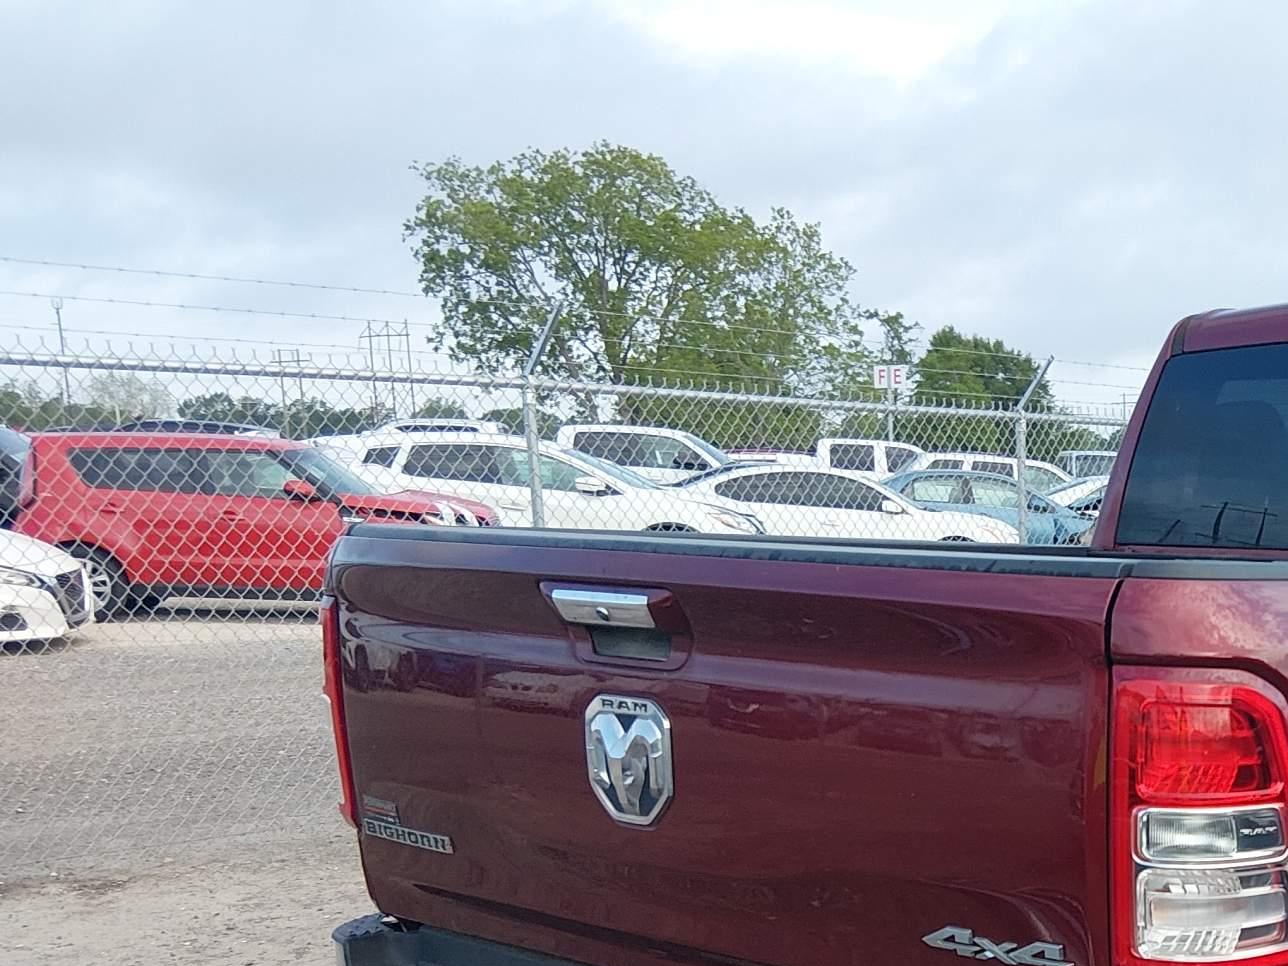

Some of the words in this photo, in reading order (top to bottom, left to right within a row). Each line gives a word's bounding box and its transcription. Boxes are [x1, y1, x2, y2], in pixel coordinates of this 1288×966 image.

[878, 368, 886, 385] F
[893, 368, 902, 385] E
[600, 698, 648, 713] RAM
